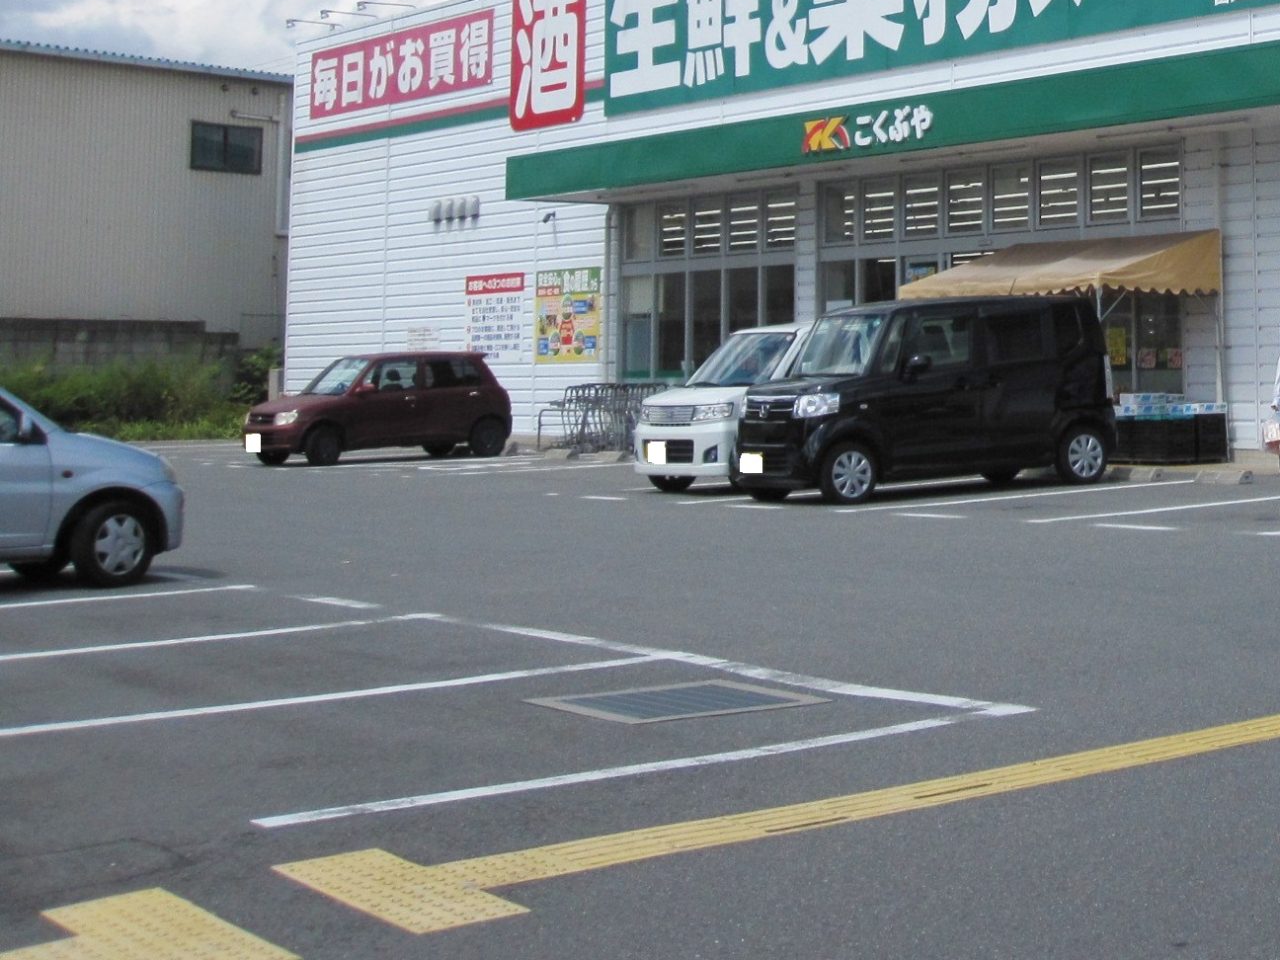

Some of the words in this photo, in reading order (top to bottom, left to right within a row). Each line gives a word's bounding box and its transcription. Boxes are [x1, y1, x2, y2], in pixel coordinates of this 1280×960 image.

[312, 19, 490, 110] 毎日がお買得
[854, 104, 934, 146] こくぶや
